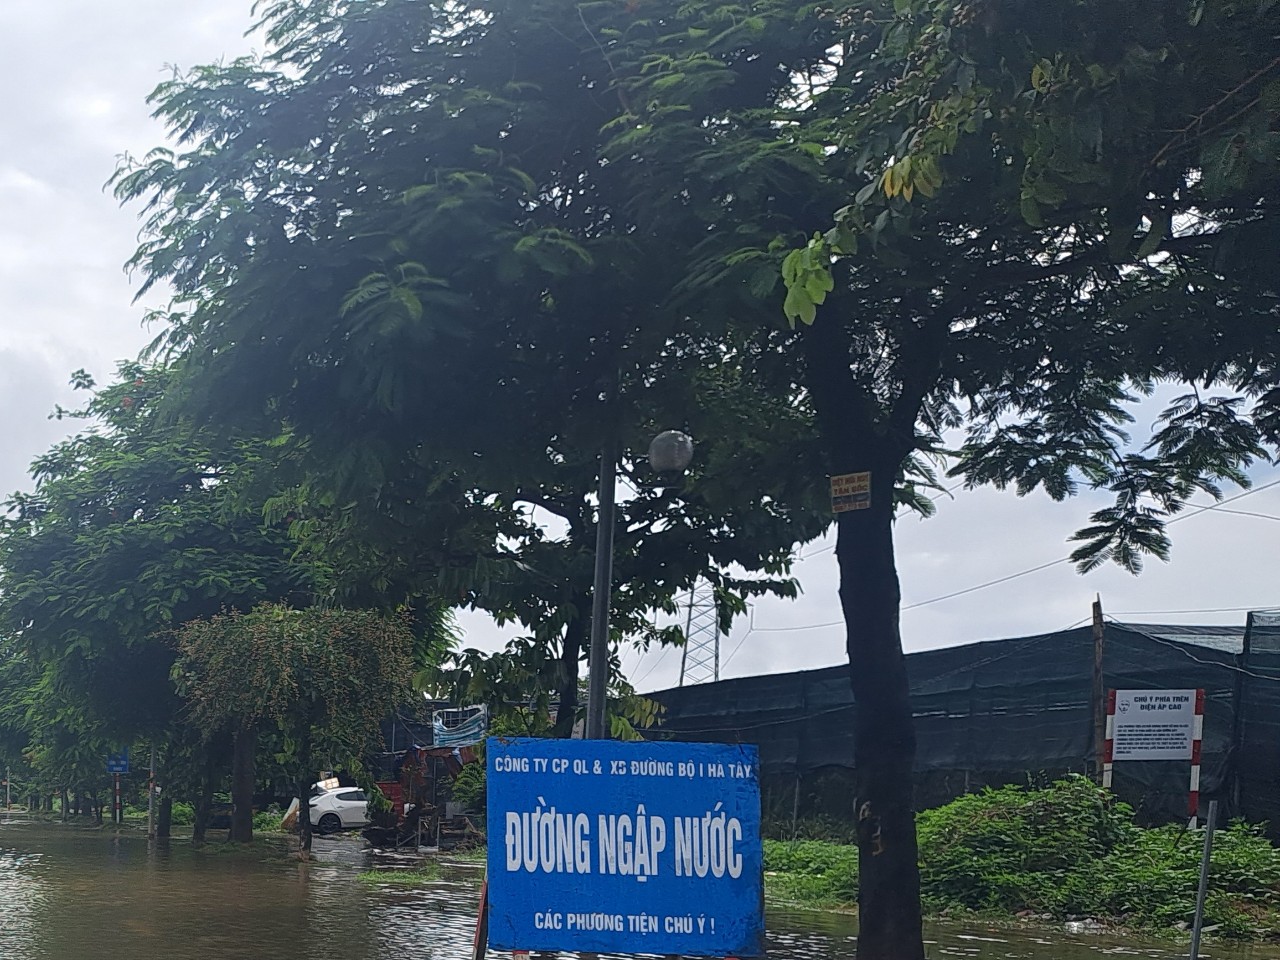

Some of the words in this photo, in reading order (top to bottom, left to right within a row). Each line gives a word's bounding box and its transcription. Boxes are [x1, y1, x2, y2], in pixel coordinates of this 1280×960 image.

[495, 754, 529, 772] CÔNG
[533, 758, 548, 772] TY
[551, 758, 569, 773] CP
[573, 759, 589, 775] QL
[593, 759, 602, 774] &
[630, 756, 674, 776] ĐƯỜNG
[678, 759, 695, 780] BỘ
[708, 760, 725, 778] HÀ
[728, 761, 751, 778] TÂY
[505, 796, 591, 874] ĐƯỜNG
[598, 804, 666, 882] NGẬP
[674, 801, 743, 879] NƯỚC
[534, 909, 562, 930] CÁC
[567, 911, 624, 932] PHƯƠNG
[627, 912, 659, 936] TIỆN
[664, 913, 693, 934] CHÚ
[698, 913, 707, 934] Ý
